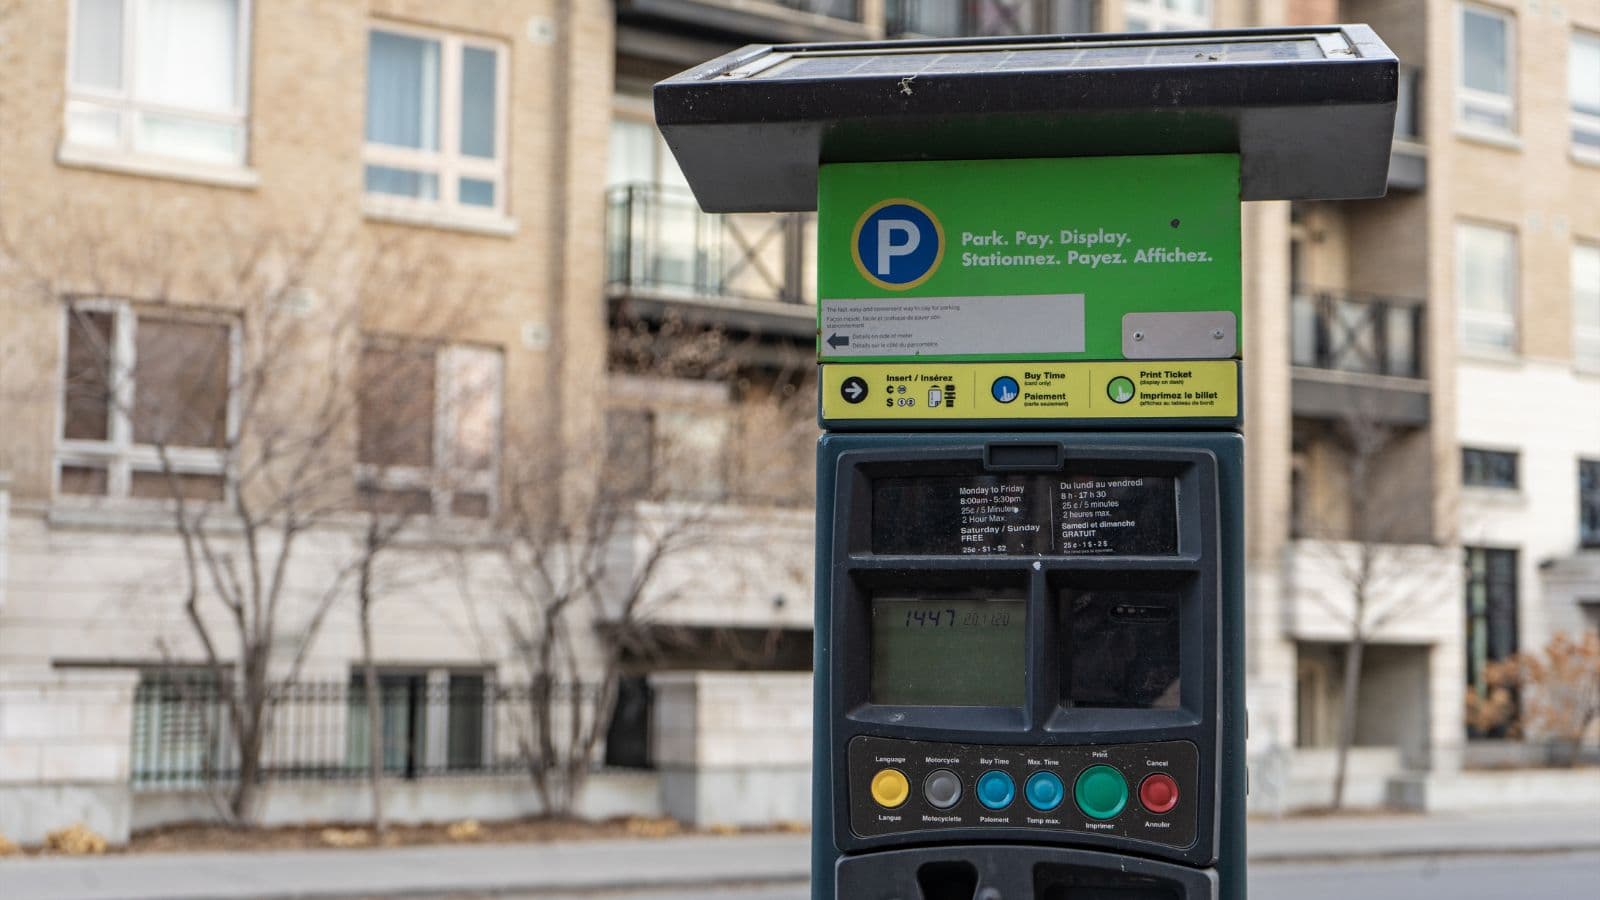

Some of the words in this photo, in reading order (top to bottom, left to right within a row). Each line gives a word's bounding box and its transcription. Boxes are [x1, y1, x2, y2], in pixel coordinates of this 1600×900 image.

[962, 230, 1009, 247] Park.
[1015, 231, 1053, 250] Pay.
[1060, 228, 1132, 248] Display.
[878, 219, 920, 275] P
[962, 249, 1060, 267] Stationnez.
[1067, 249, 1127, 269] Payez.
[1134, 246, 1213, 264] Affichez.
[886, 374, 912, 382] Insert
[920, 374, 953, 382] Insérez
[1024, 372, 1041, 380] Buy
[1043, 371, 1066, 379] Time
[1164, 370, 1192, 378] Ticket
[1024, 392, 1066, 400] Paiement
[1140, 392, 1182, 400] Imprimez
[1184, 391, 1192, 399] le
[1195, 391, 1218, 399] billet
[1060, 482, 1071, 490] Du
[1073, 481, 1094, 489] lundi
[1107, 478, 1143, 487] vendredi
[960, 486, 989, 495] Monday
[1000, 485, 1025, 494] Friday
[1061, 492, 1066, 500] 8
[1078, 491, 1088, 499] 17
[1096, 490, 1107, 498] 30
[960, 497, 988, 505] 8:00am
[1062, 501, 1071, 510] 25
[1090, 500, 1119, 508] minutes
[1069, 510, 1093, 518] heures
[969, 515, 988, 523] Hour
[960, 526, 1000, 534] Saturday
[1007, 524, 1040, 532] Sunday
[1061, 522, 1089, 530] Samedi
[1099, 520, 1136, 528] dimanche
[961, 534, 984, 542] FREE
[1062, 530, 1096, 538] GRATUIT
[875, 756, 906, 764] Language
[925, 756, 960, 764] Motorcycle
[980, 757, 993, 766] Buy
[1146, 759, 1168, 767] Cancel
[878, 814, 902, 822] Langue
[922, 815, 962, 823] Motocyclette
[1026, 817, 1044, 825] Temp
[1085, 822, 1115, 830] Imprimer
[1144, 821, 1171, 829] Annuler
